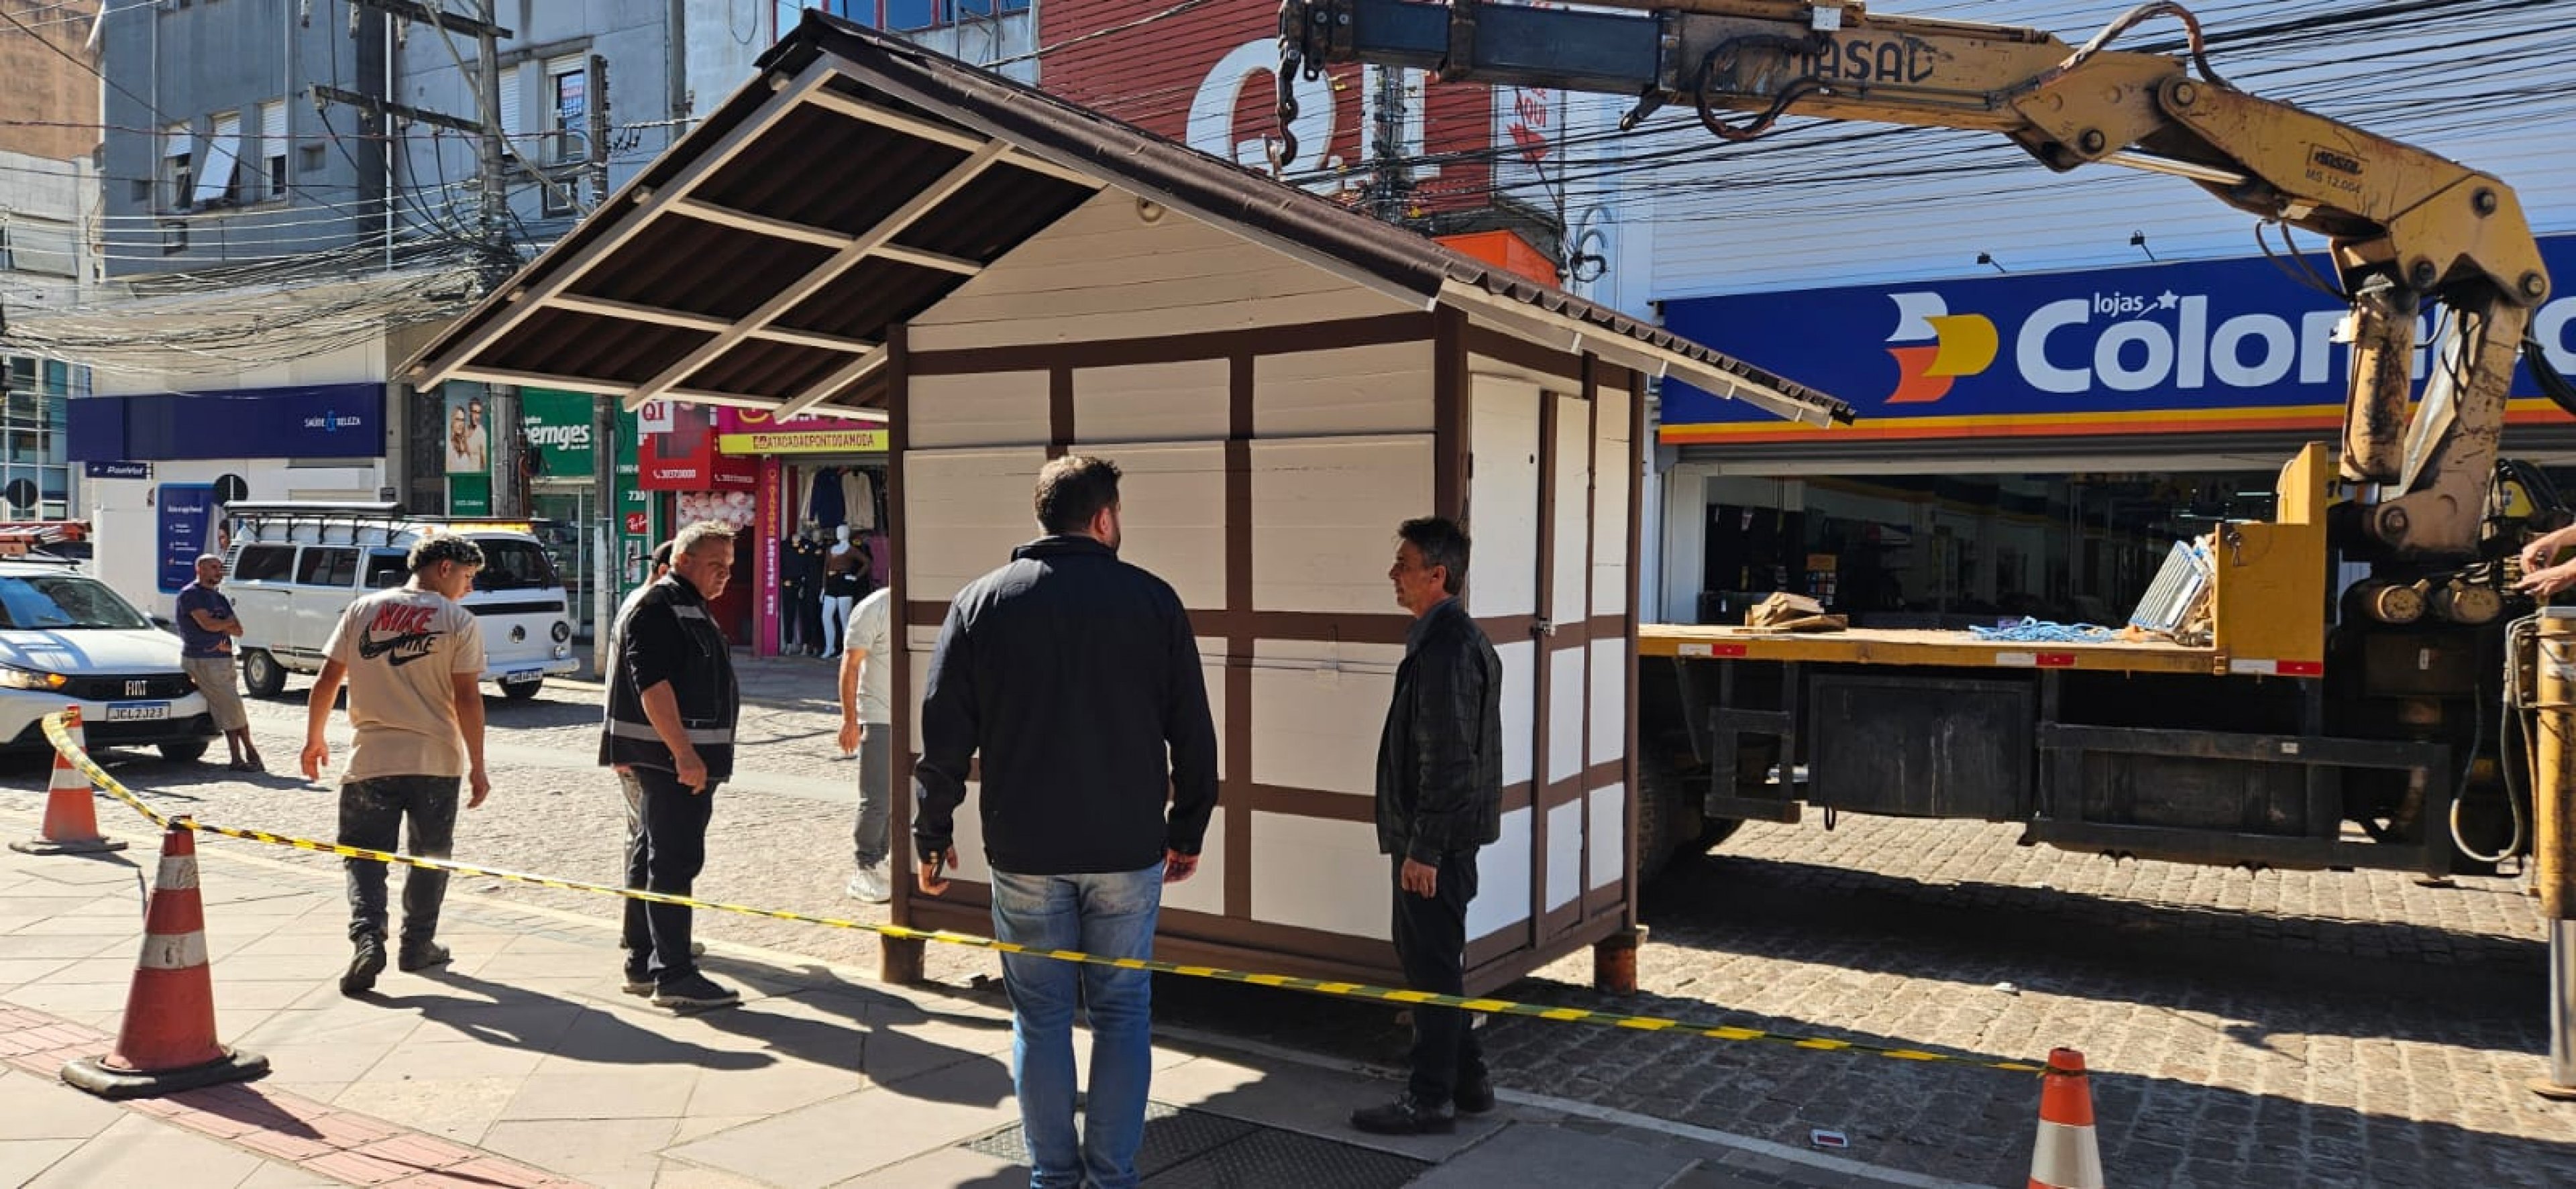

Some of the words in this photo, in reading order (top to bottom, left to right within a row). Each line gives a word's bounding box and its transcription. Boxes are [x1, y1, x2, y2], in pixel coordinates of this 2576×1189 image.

[2094, 292, 2143, 317] lojas
[643, 402, 665, 421] QI
[372, 603, 438, 634] NIKE
[125, 680, 148, 696] FIAT
